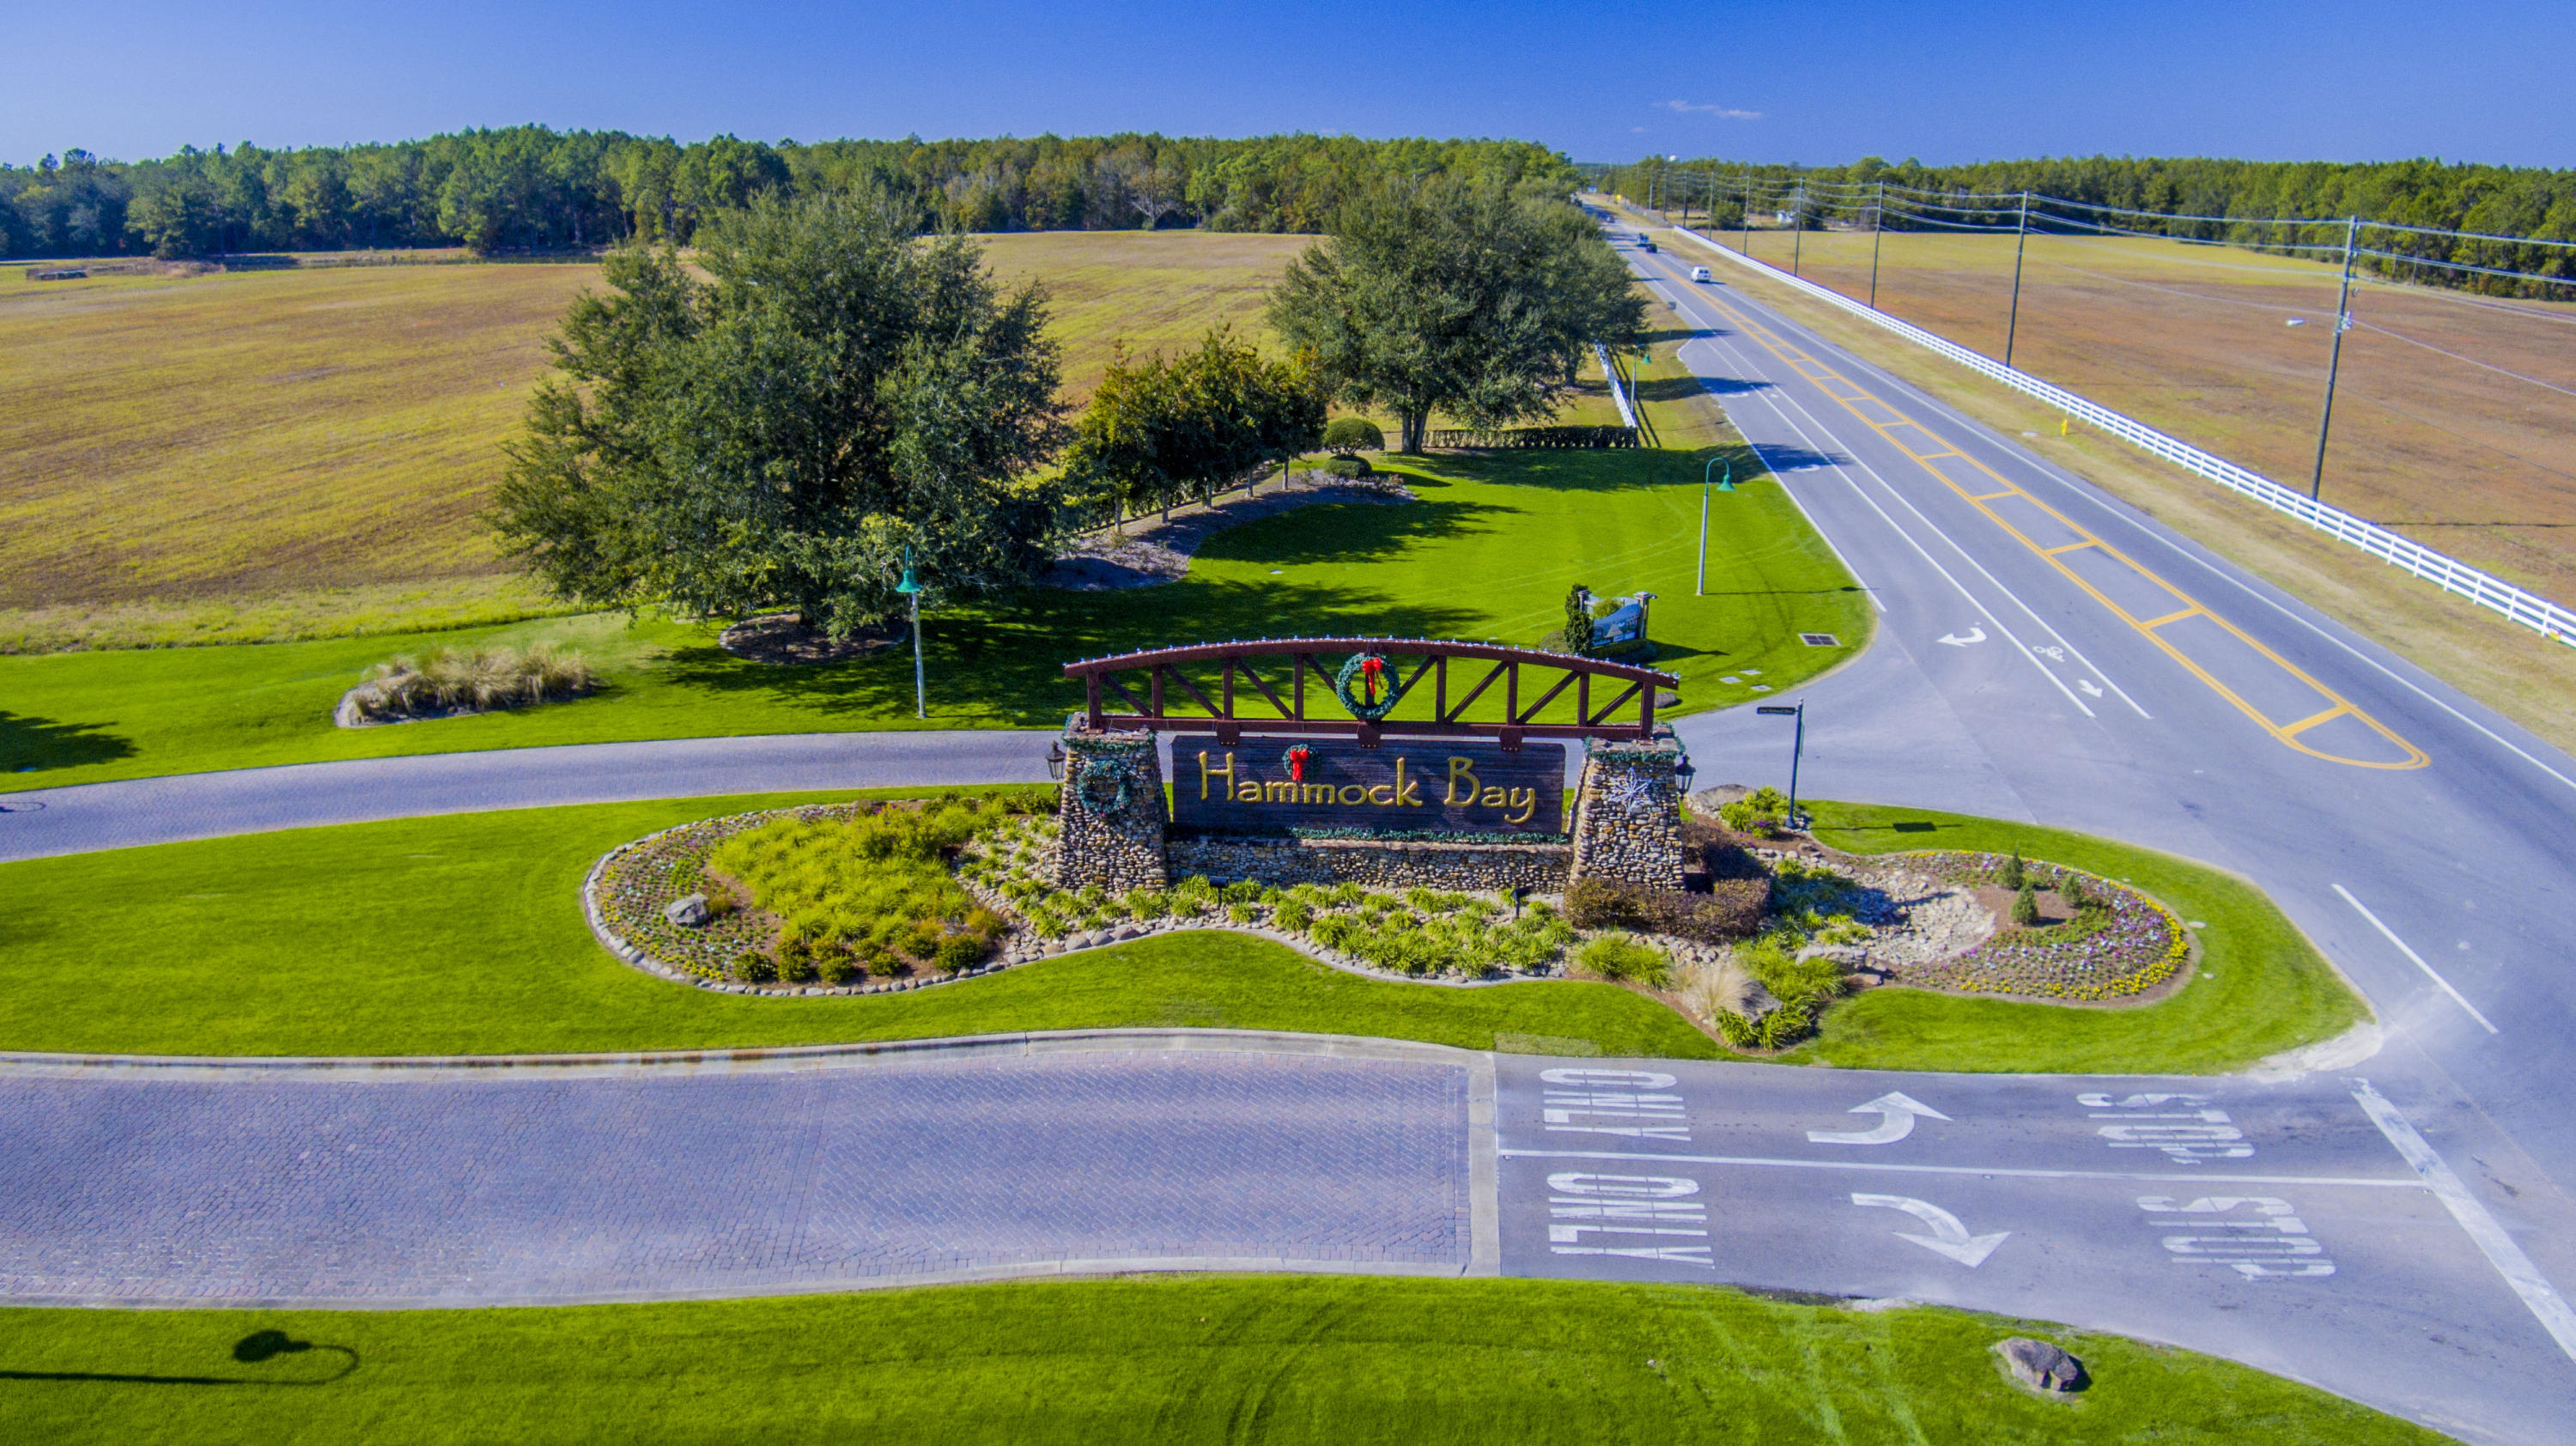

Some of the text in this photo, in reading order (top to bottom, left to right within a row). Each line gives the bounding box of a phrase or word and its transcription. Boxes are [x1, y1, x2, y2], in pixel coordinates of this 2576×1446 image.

[1199, 750, 1536, 824] Hammock Bay
[1540, 1068, 1692, 1141] ONLY
[2076, 1092, 2256, 1164] STOP
[1546, 1173, 1715, 1269] ONLY
[2136, 1195, 2336, 1280] STOP
